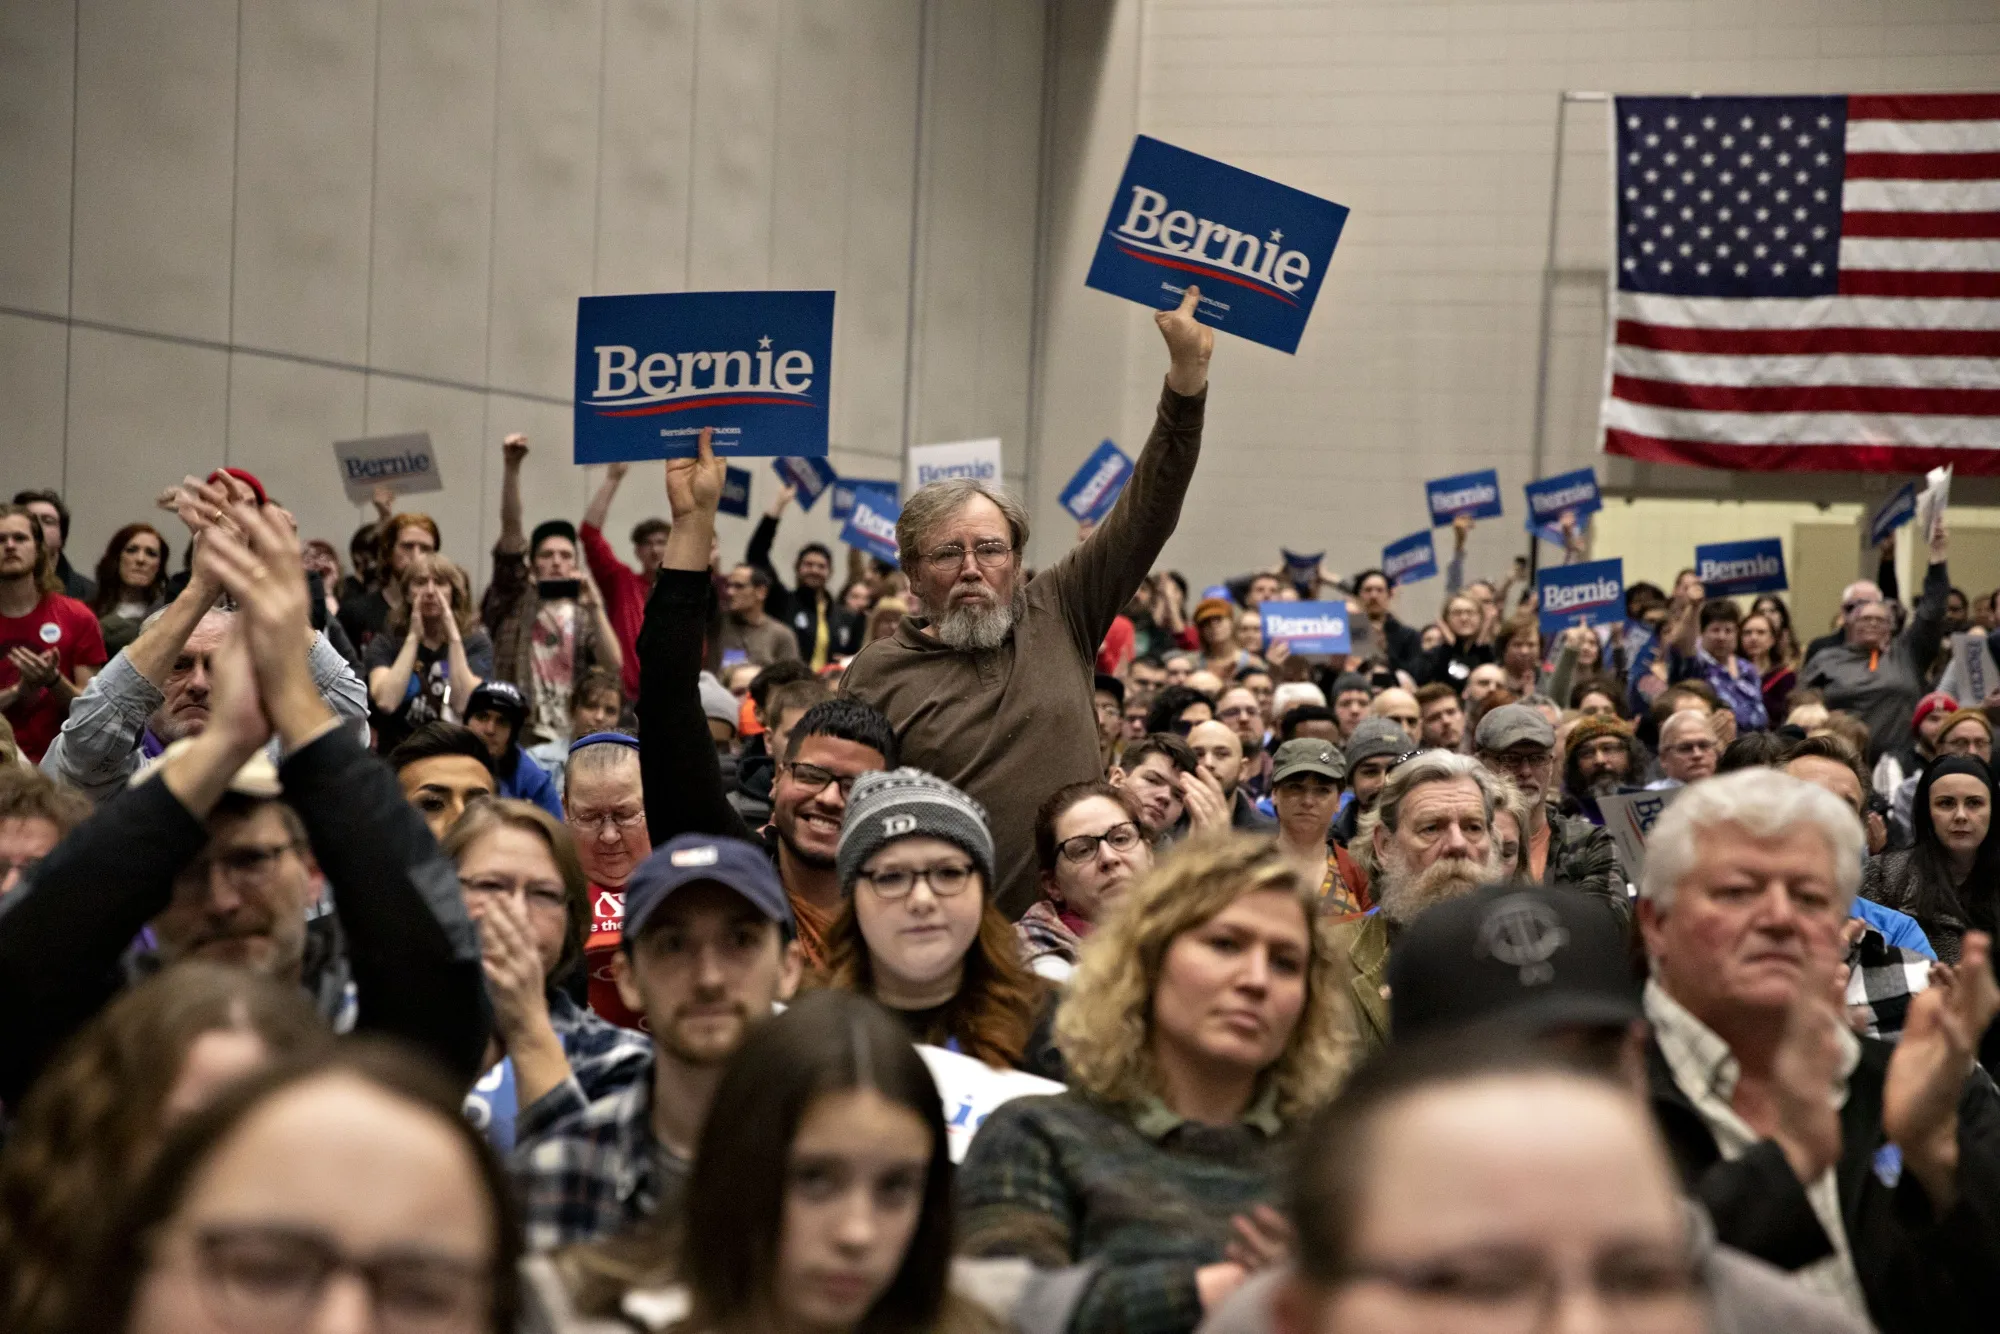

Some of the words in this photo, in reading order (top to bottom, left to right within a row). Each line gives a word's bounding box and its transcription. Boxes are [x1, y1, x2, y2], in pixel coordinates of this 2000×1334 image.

[1116, 184, 1311, 293] Bernie
[592, 334, 814, 399] Bernie
[344, 450, 430, 477] Bernie
[1069, 452, 1125, 515] Bernie
[1431, 483, 1496, 514] Bernie
[1531, 482, 1596, 515] Bernie
[1701, 553, 1779, 584] Bernie
[1544, 576, 1620, 612] Bernie
[1266, 613, 1345, 636] Bernie
